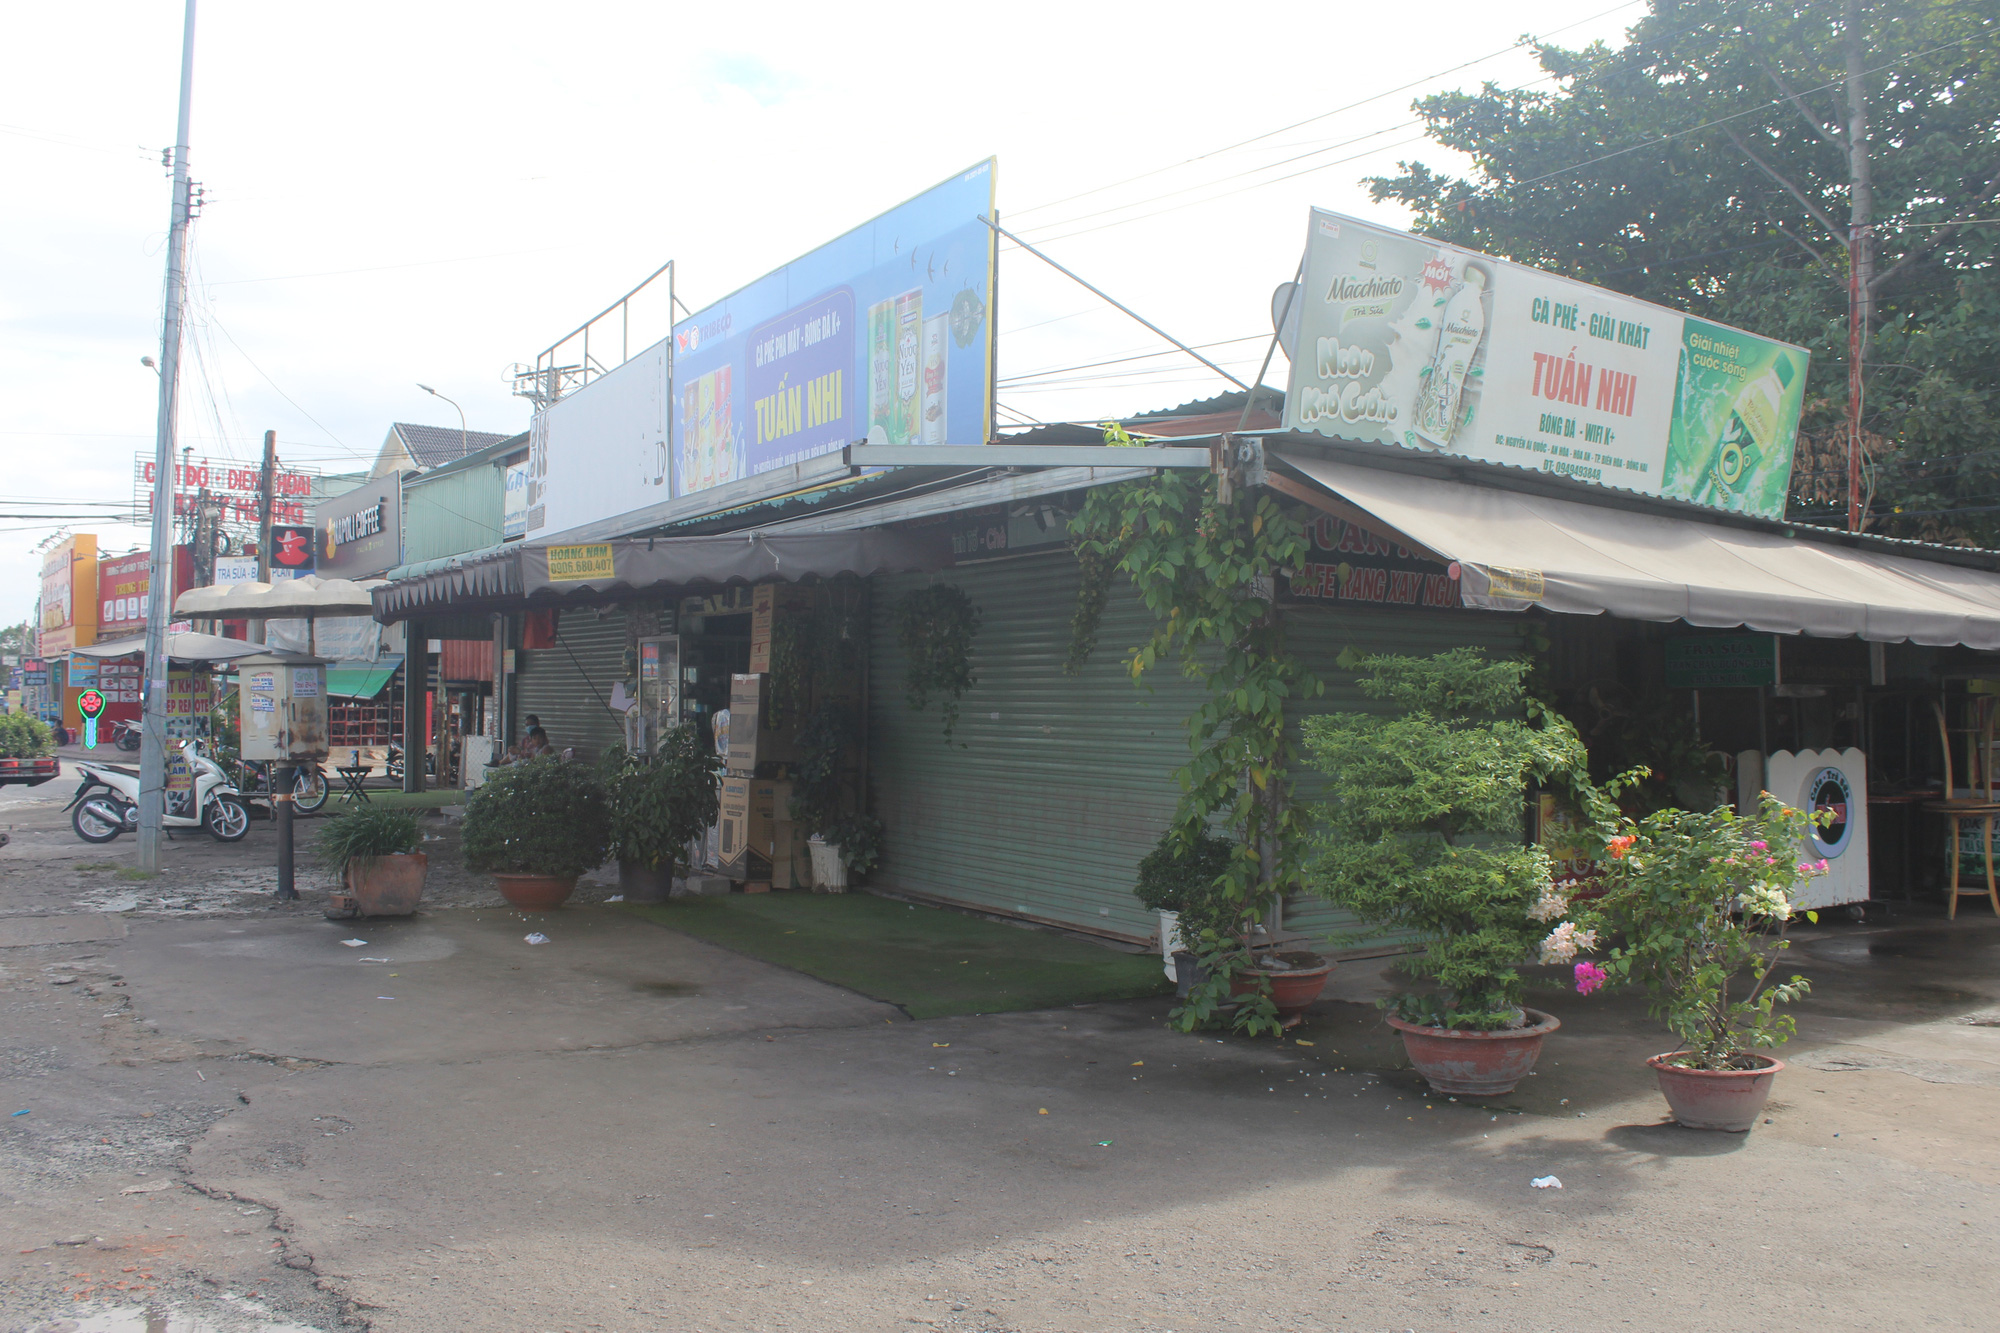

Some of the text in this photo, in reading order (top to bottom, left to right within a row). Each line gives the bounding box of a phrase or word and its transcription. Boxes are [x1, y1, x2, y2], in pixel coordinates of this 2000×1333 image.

[1327, 275, 1402, 300] Macchiato
[1425, 266, 1450, 282] MỚI
[1353, 306, 1366, 316] Trà
[700, 313, 732, 342] TRIBECO
[1445, 322, 1478, 337] Macchiato
[1553, 304, 1578, 331] PHÊ
[1589, 311, 1615, 341] GIẢI
[1618, 321, 1650, 350] KHÁT
[1318, 338, 1374, 378] NGON
[1690, 333, 1739, 360] Giải nhiệt
[1694, 354, 1746, 381] cuộc sống
[1532, 346, 1637, 417] TUẤN NHI
[755, 369, 842, 445] TUẤN NHI
[1539, 412, 1616, 446] BÓNG ĐÁ WIFI K+
[1556, 462, 1601, 480] 0949493848
[356, 504, 380, 538] COFFEE
[586, 546, 607, 558] NAM
[550, 559, 611, 574] 0906.680.407
[1290, 562, 1337, 598] CAFE
[1338, 567, 1387, 602] RANG
[1386, 570, 1422, 605] XAY
